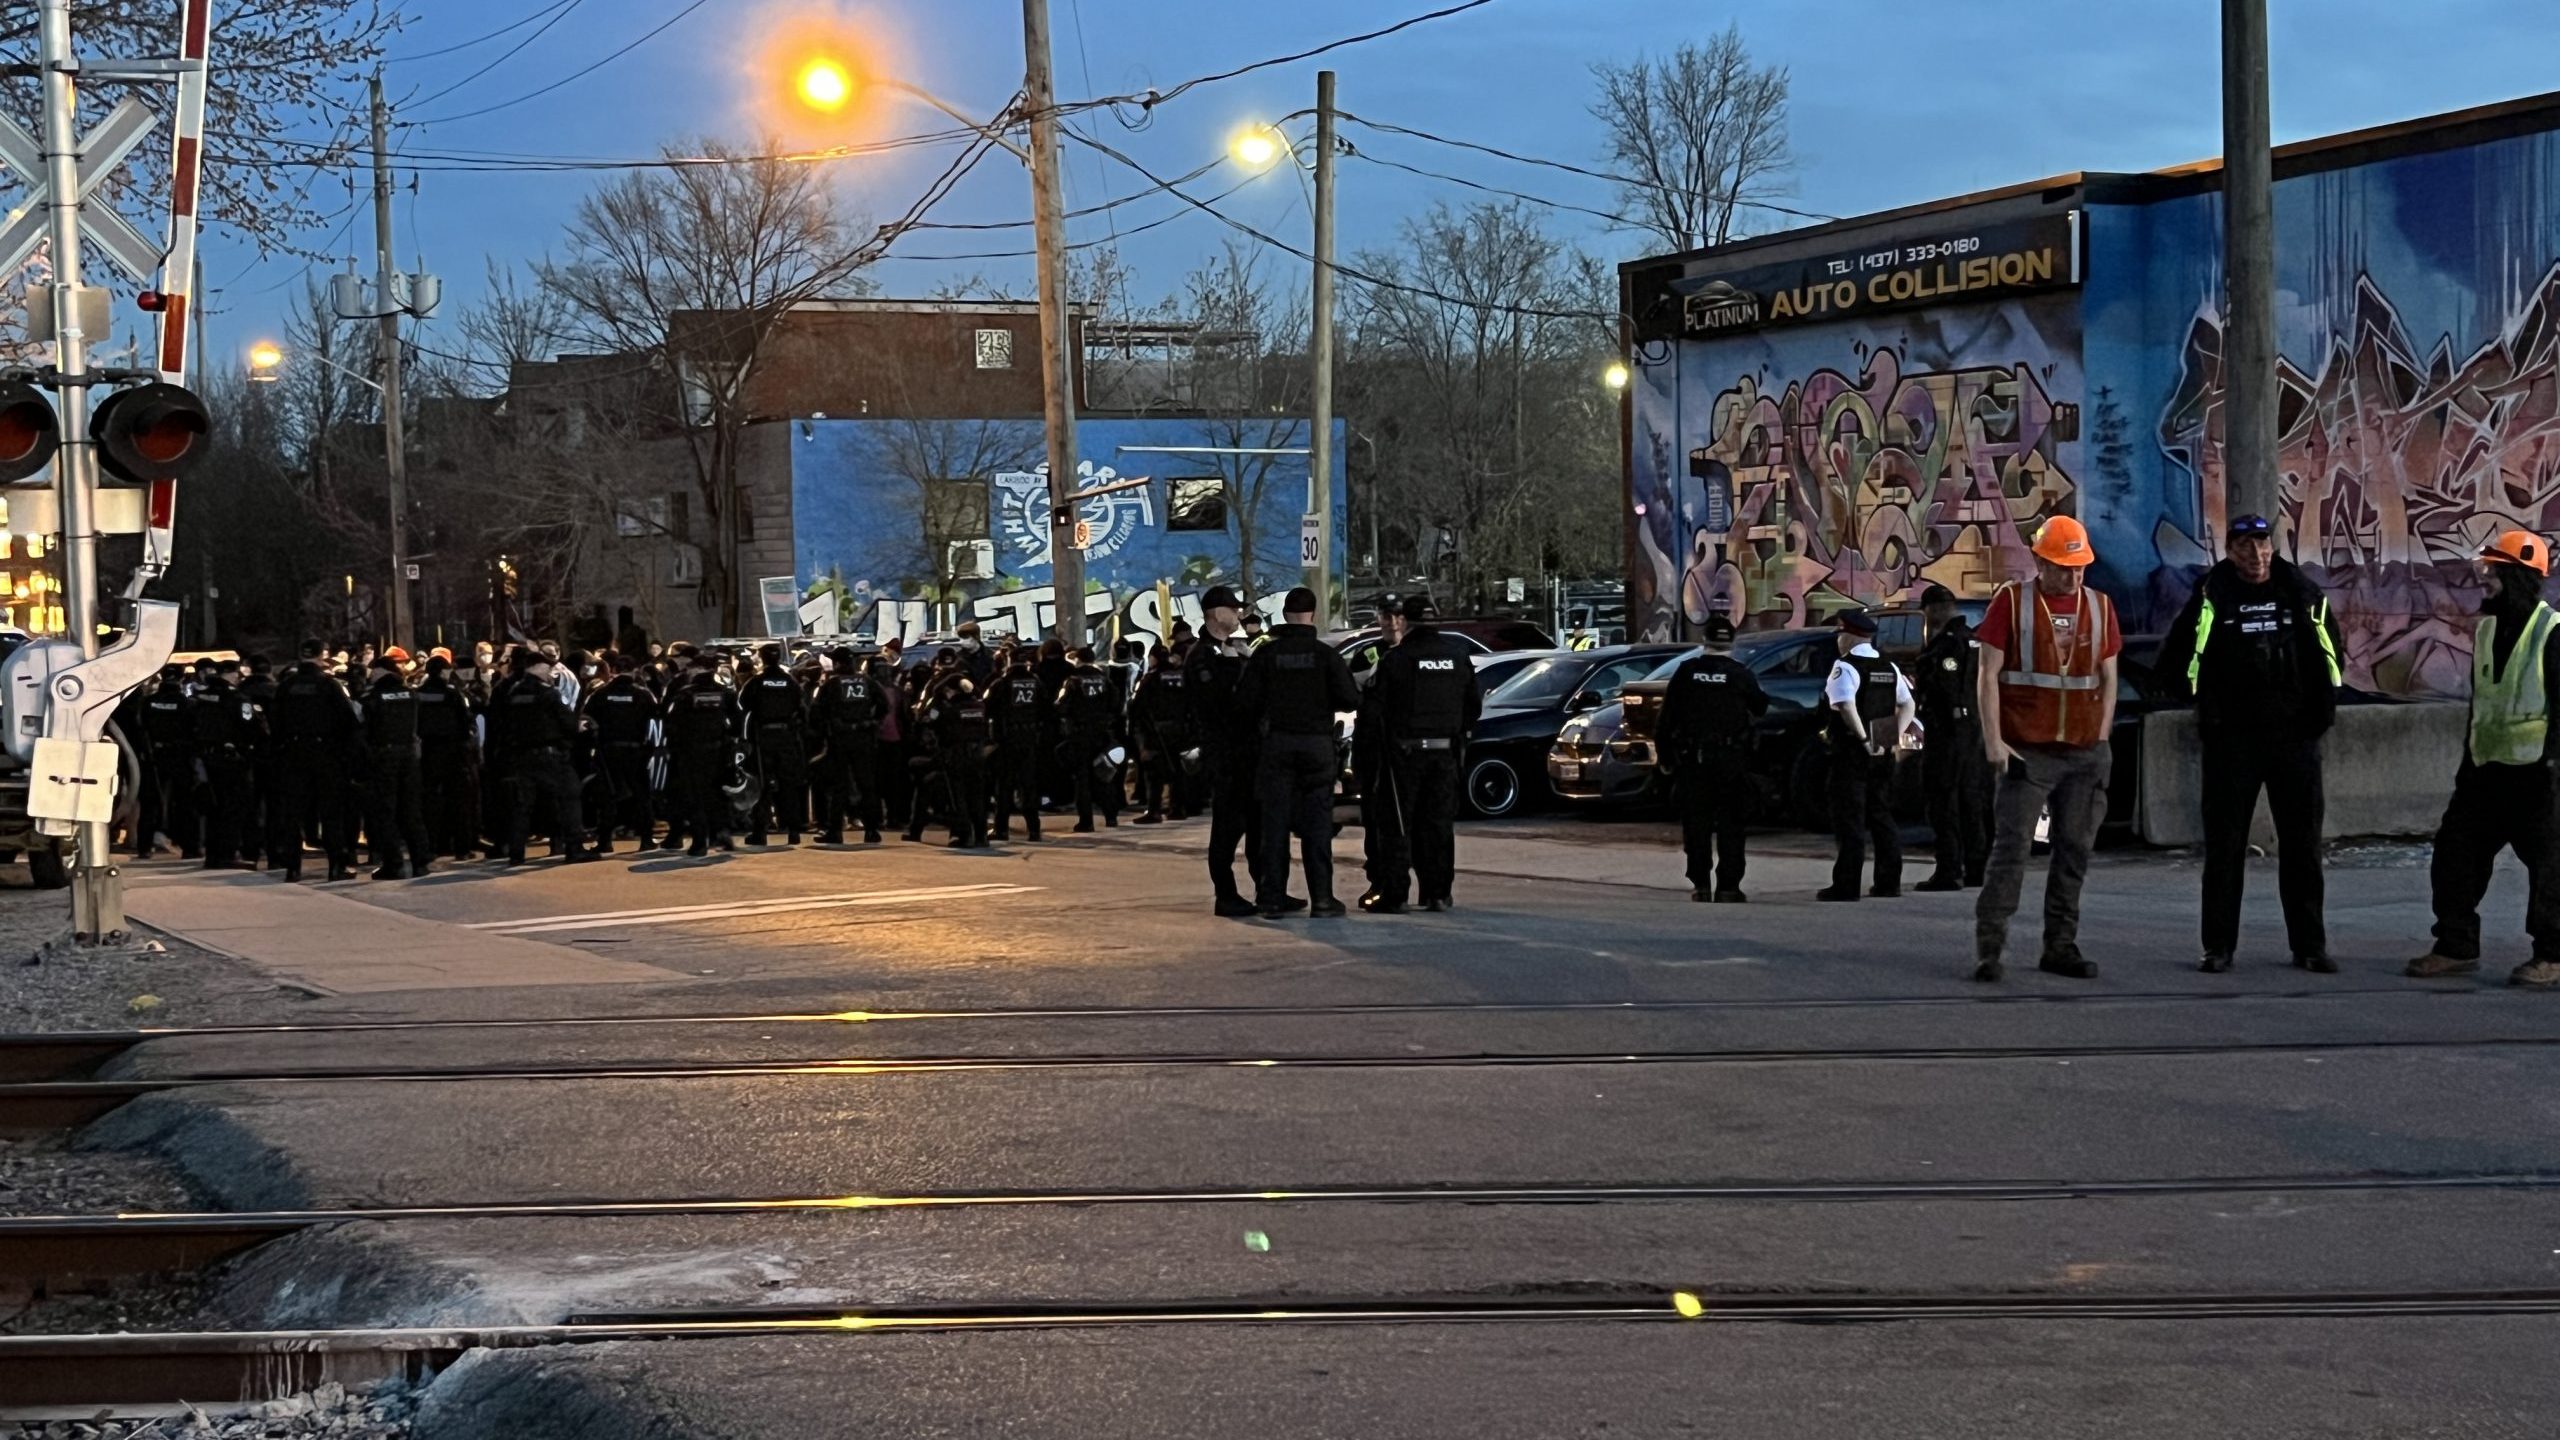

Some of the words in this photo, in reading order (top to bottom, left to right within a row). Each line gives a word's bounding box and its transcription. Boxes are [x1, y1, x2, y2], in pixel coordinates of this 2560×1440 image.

[1860, 248, 1899, 272] (437)
[1906, 236, 1980, 262] 333-0180
[1770, 282, 1857, 320] AUTO
[1867, 247, 2052, 304] COLLISION
[1684, 303, 1759, 332] PLATINUM
[1302, 536, 1319, 561] 30
[1418, 660, 1454, 670] POLICE
[1692, 672, 1727, 683] POLICE
[846, 685, 865, 698] A2
[1015, 690, 1034, 703] A2
